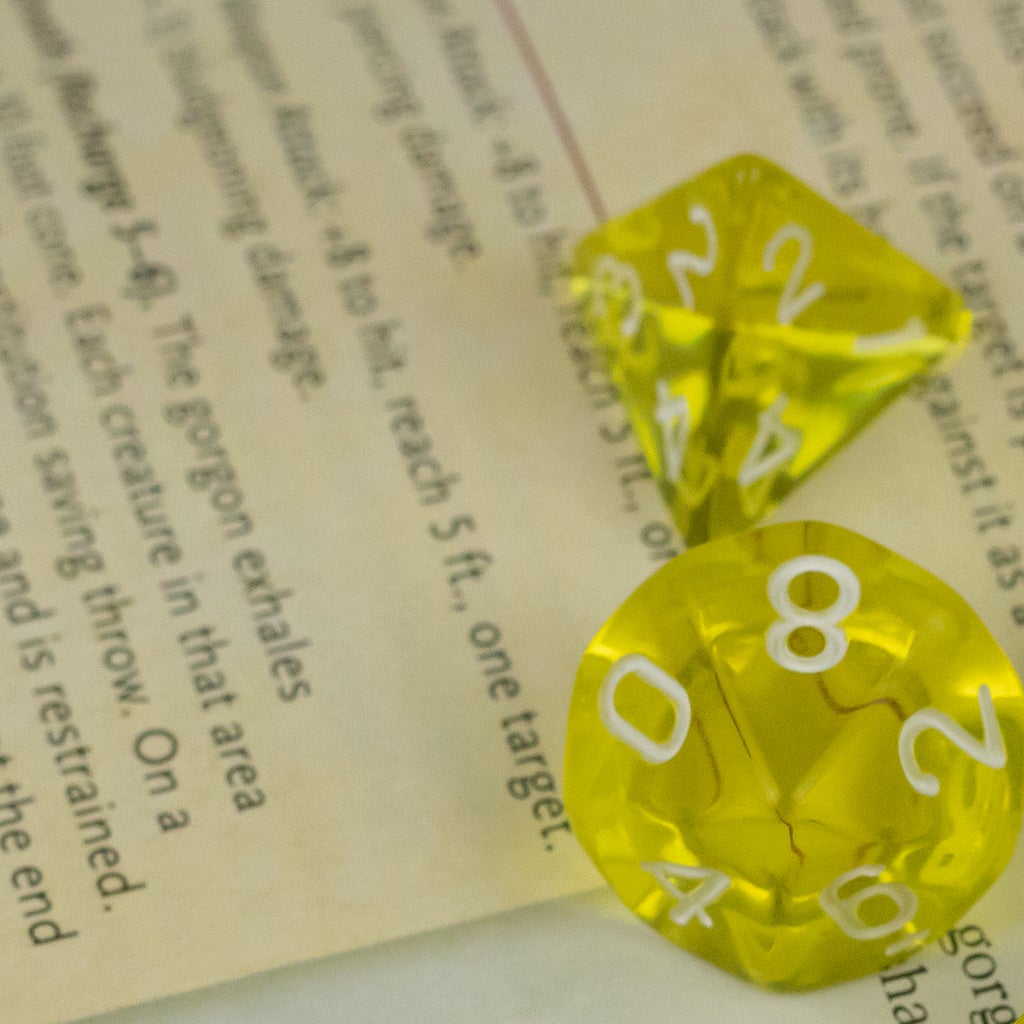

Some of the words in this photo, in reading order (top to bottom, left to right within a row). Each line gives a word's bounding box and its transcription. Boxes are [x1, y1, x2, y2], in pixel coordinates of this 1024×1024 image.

[399, 128, 483, 275] damage.
[919, 191, 973, 254] the
[335, 272, 379, 317] to
[762, 221, 827, 326] 2
[63, 302, 134, 398] Each
[151, 311, 203, 388] The
[244, 246, 328, 404] damage.
[358, 317, 409, 392] hit,
[161, 398, 255, 541] gorgon
[384, 394, 462, 507] reach
[654, 379, 690, 483] 4
[737, 393, 803, 487] 4
[912, 374, 1000, 498] gainst
[972, 502, 1014, 536] it
[32, 447, 107, 582] saving
[98, 403, 184, 568] creature
[427, 513, 477, 543] 5
[158, 572, 205, 618] in
[231, 548, 313, 704] exhales
[442, 549, 494, 614] ft.,
[765, 554, 861, 673] 8
[16, 632, 62, 673] is
[80, 583, 151, 719] throw.
[176, 624, 240, 713] that
[467, 621, 522, 702] one
[598, 651, 691, 765] 0
[898, 683, 1007, 797] 2
[33, 682, 148, 914] restrained.
[131, 726, 181, 797] On
[209, 722, 267, 814] area
[499, 709, 571, 854] target.
[155, 808, 192, 835] a
[9, 865, 80, 948] end
[640, 860, 733, 929] 4
